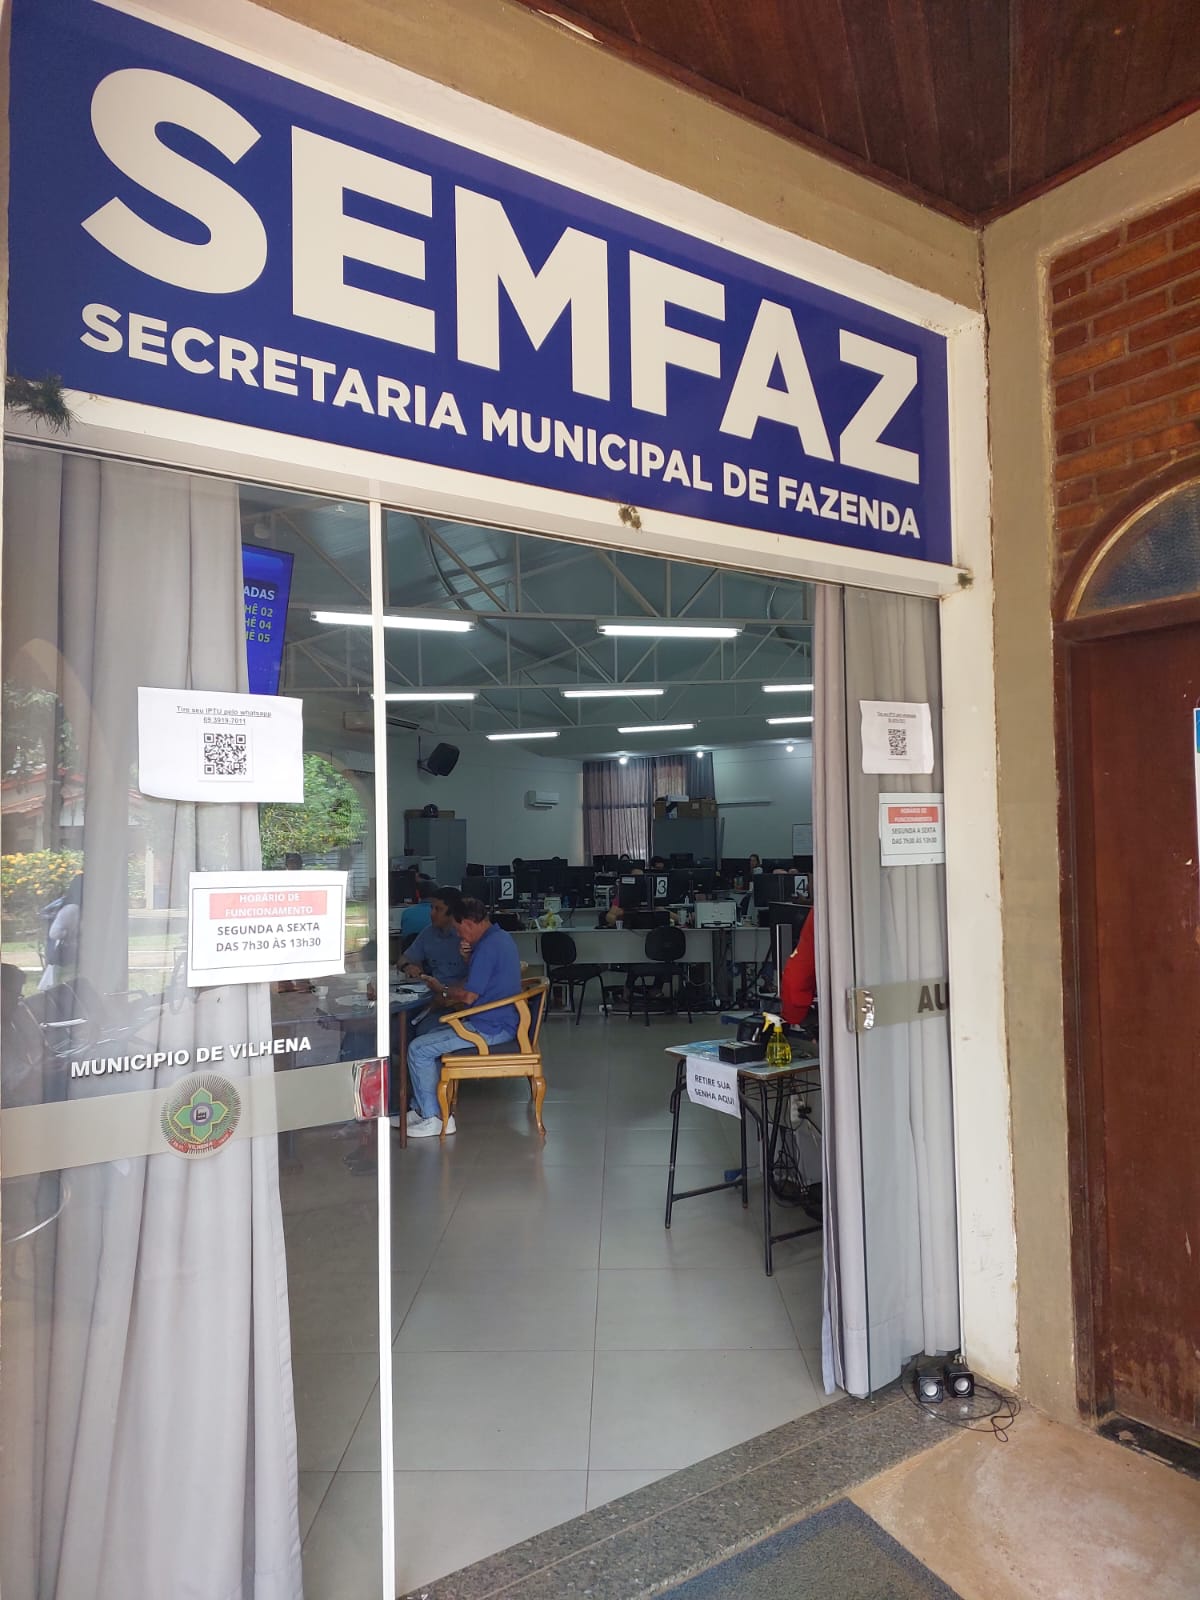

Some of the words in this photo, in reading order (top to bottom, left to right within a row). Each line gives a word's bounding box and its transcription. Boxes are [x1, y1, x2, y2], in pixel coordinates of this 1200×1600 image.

[81, 68, 920, 485] SEMFAZ
[80, 303, 466, 436] SECRETARIA
[482, 402, 713, 492] MUNICIPAL
[723, 462, 769, 504] DE
[778, 476, 921, 539] FAZENDA
[205, 707, 222, 715] IPTU
[502, 880, 513, 897] 2
[657, 878, 667, 895] 3
[795, 878, 806, 894] 4
[239, 892, 285, 904] HORÁRIO
[287, 892, 300, 901] DE
[225, 905, 313, 917] FUNCIONAMENTO
[217, 924, 274, 936] SEGUNDA
[276, 924, 284, 933] A
[287, 922, 320, 932] SEXTA
[216, 942, 239, 952] DAS
[242, 940, 270, 951] 7h30
[290, 937, 321, 947] 13h30
[71, 1050, 190, 1078] MUNICIPIO
[196, 1045, 224, 1064] DE
[229, 1037, 312, 1059] VILHENA
[694, 1074, 716, 1088] RETIRE
[717, 1080, 732, 1090] SUA
[694, 1088, 717, 1101] SENHA
[717, 1094, 735, 1105] AQUI
